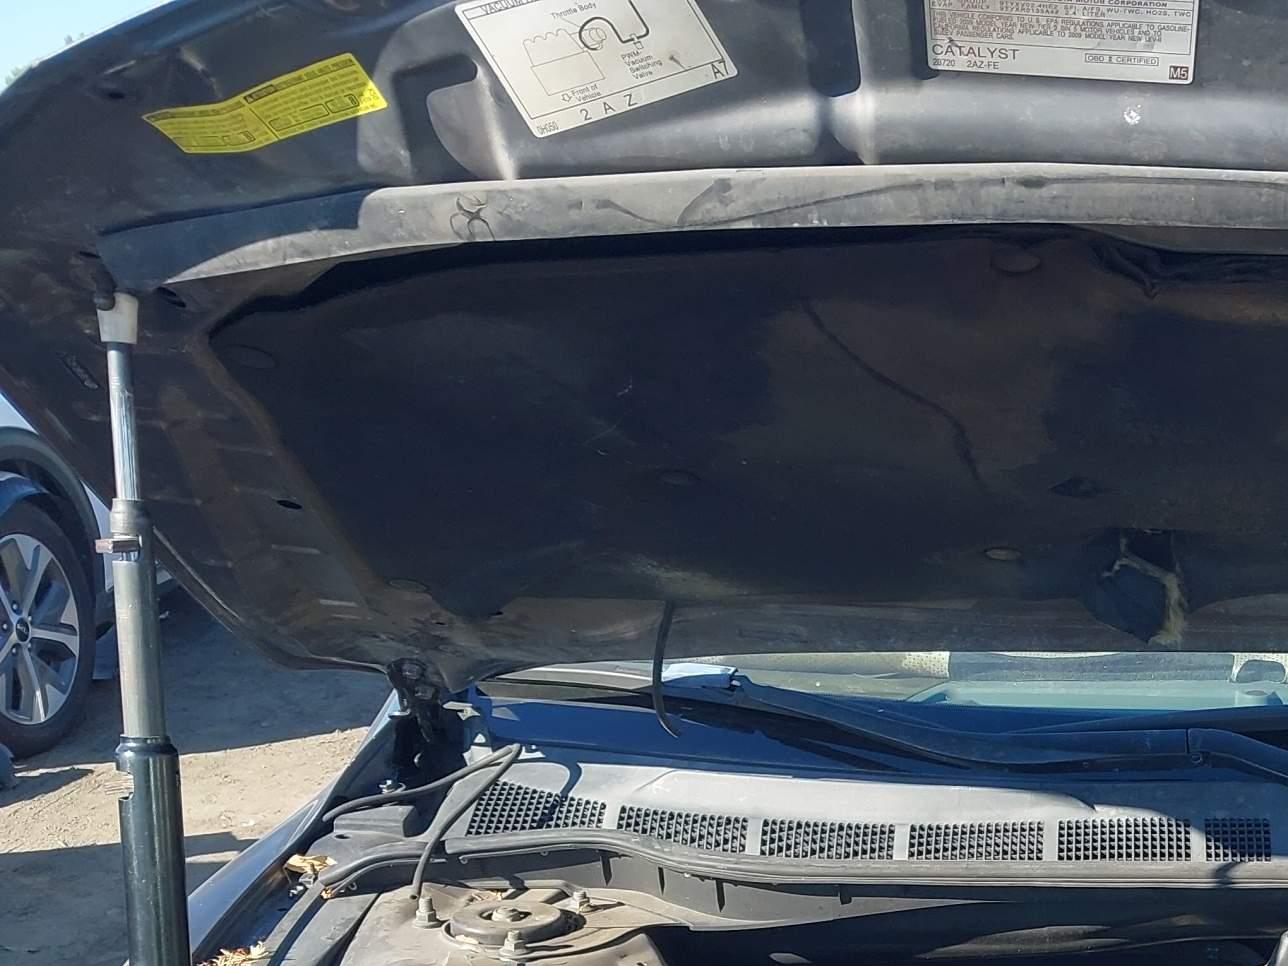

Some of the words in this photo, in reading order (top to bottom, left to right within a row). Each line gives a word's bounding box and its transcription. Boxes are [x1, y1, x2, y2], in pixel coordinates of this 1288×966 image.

[551, 7, 578, 19] Throttle
[579, 2, 597, 13] Body
[1062, 19, 1104, 28] REGULATIONS
[1107, 22, 1143, 30] APPLICABLE
[932, 43, 1020, 60] CATALYST
[624, 55, 653, 67] Vacuum
[966, 60, 1000, 70] 2AZ-FE
[1087, 54, 1104, 62] OBD
[1116, 56, 1157, 64] CERTIFIED
[629, 59, 663, 73] Switching
[711, 60, 729, 79] A7
[632, 70, 653, 80] Valve
[1169, 66, 1189, 80] M5
[571, 86, 590, 97] Front
[575, 91, 602, 102] Vehicle
[579, 108, 592, 121] 2
[603, 101, 616, 115] A
[623, 93, 638, 107] Z
